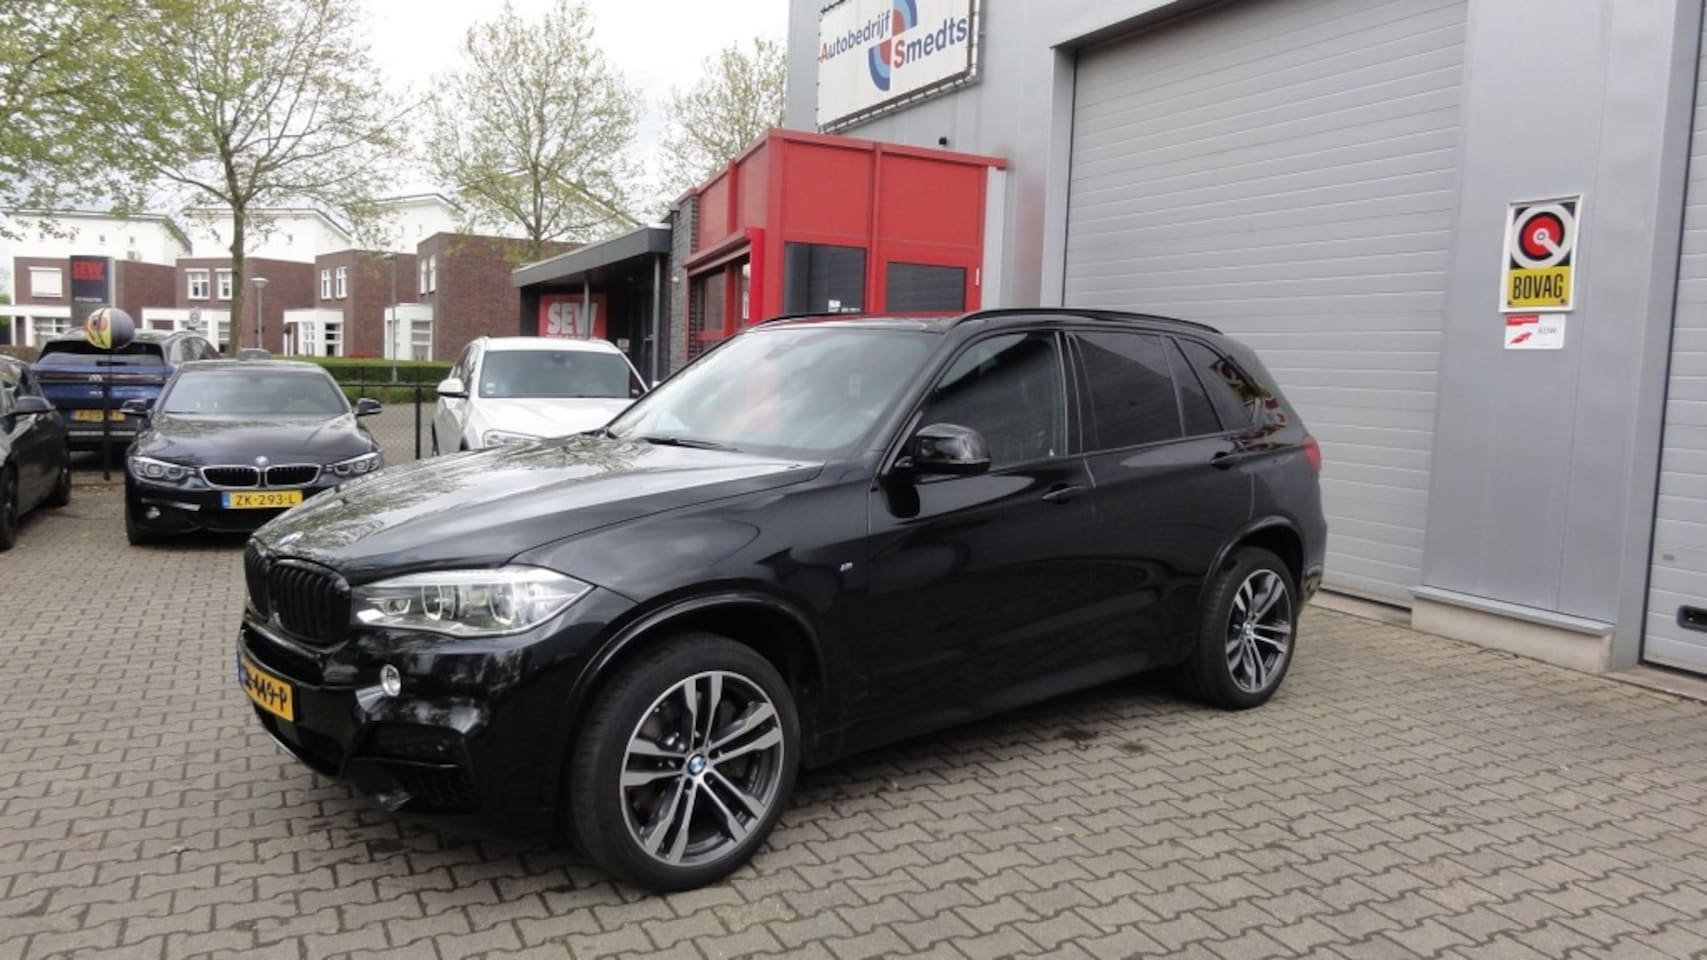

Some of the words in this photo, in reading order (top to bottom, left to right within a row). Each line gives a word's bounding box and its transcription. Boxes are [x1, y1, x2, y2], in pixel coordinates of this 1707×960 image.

[819, 9, 891, 62] Autobedrijf
[893, 16, 968, 69] Smedts
[1512, 273, 1564, 300] BOVAG
[547, 302, 598, 334] SEW
[235, 494, 297, 505] ZK-293-L
